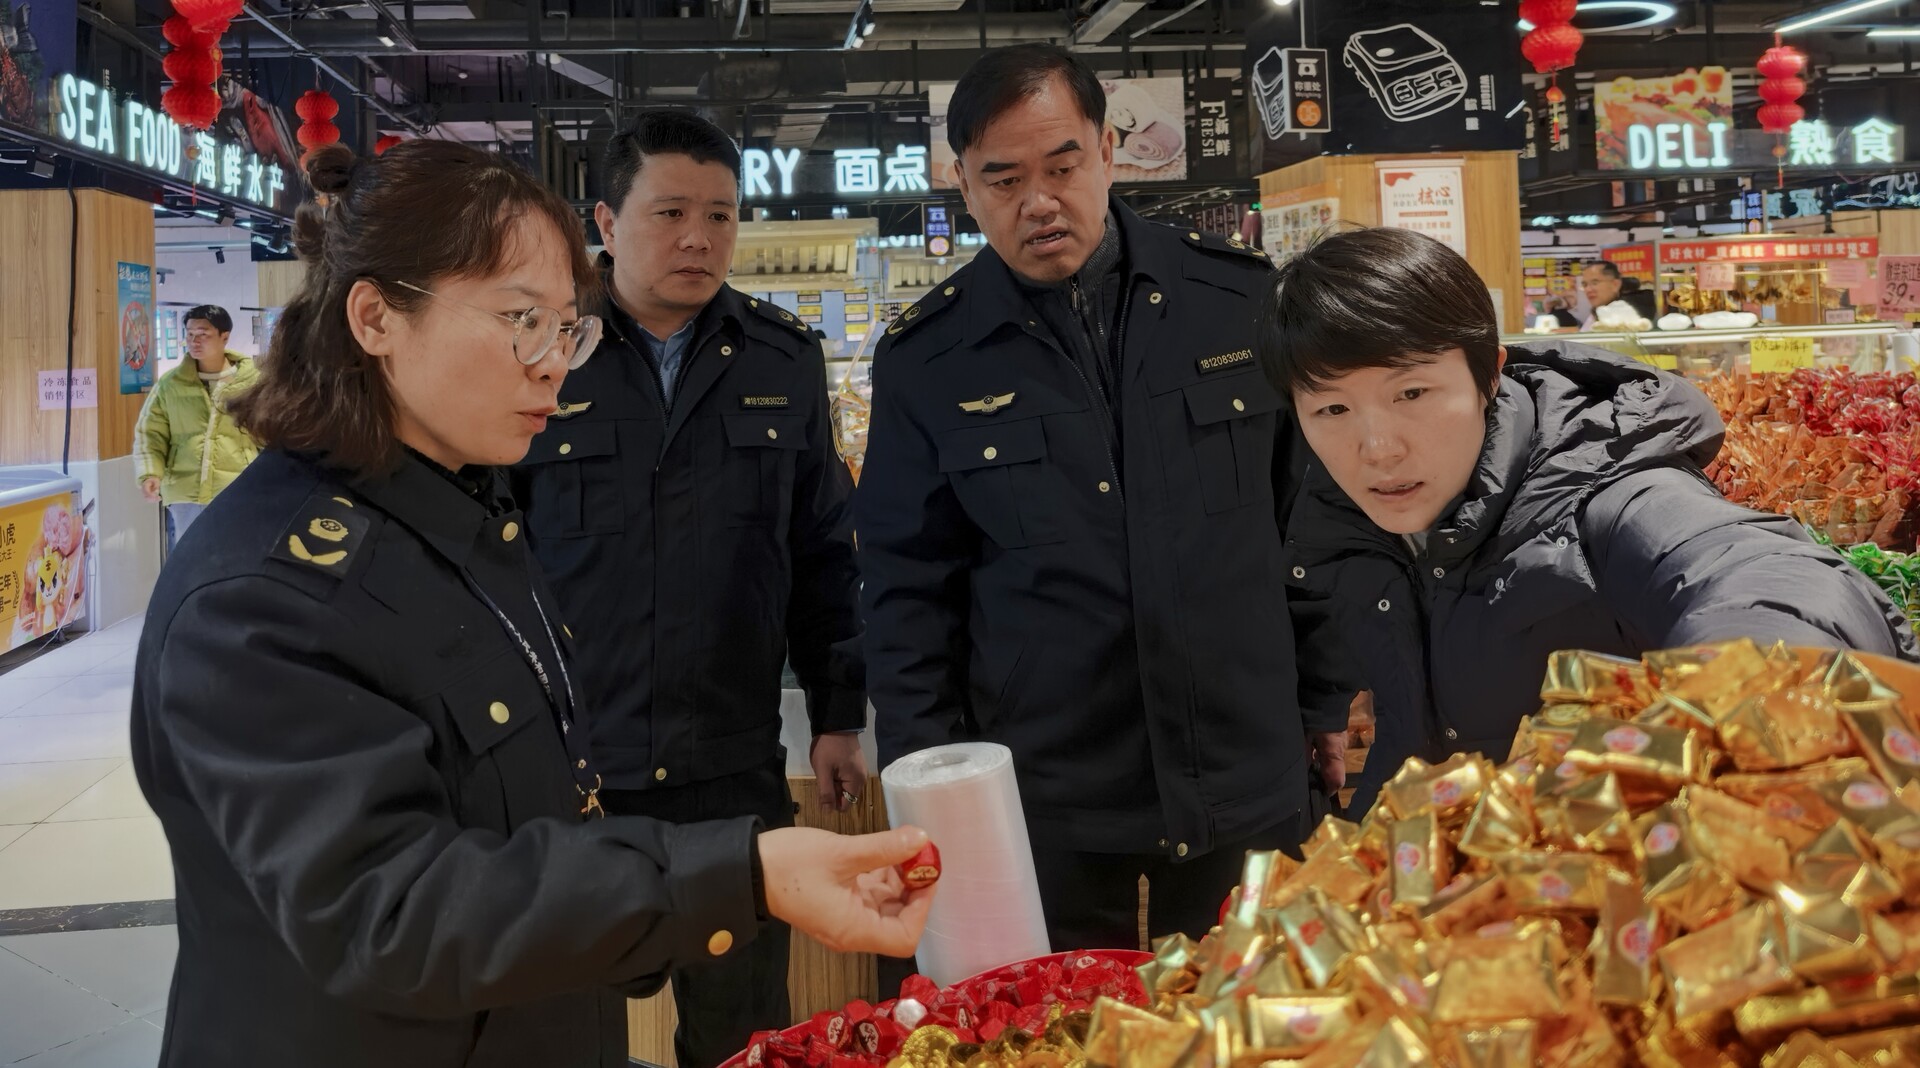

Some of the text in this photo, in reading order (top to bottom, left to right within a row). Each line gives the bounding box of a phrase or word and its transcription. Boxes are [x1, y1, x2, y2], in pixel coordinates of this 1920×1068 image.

[60, 72, 181, 176] SEA FOOD
[1200, 100, 1226, 157] FRESH
[1628, 121, 1732, 169] DELI
[1790, 117, 1896, 166] 熟食
[197, 130, 285, 208] 海鲜水产
[833, 144, 929, 192] 面点
[1200, 349, 1253, 369] 18120830061
[44, 389, 85, 400] 销售区
